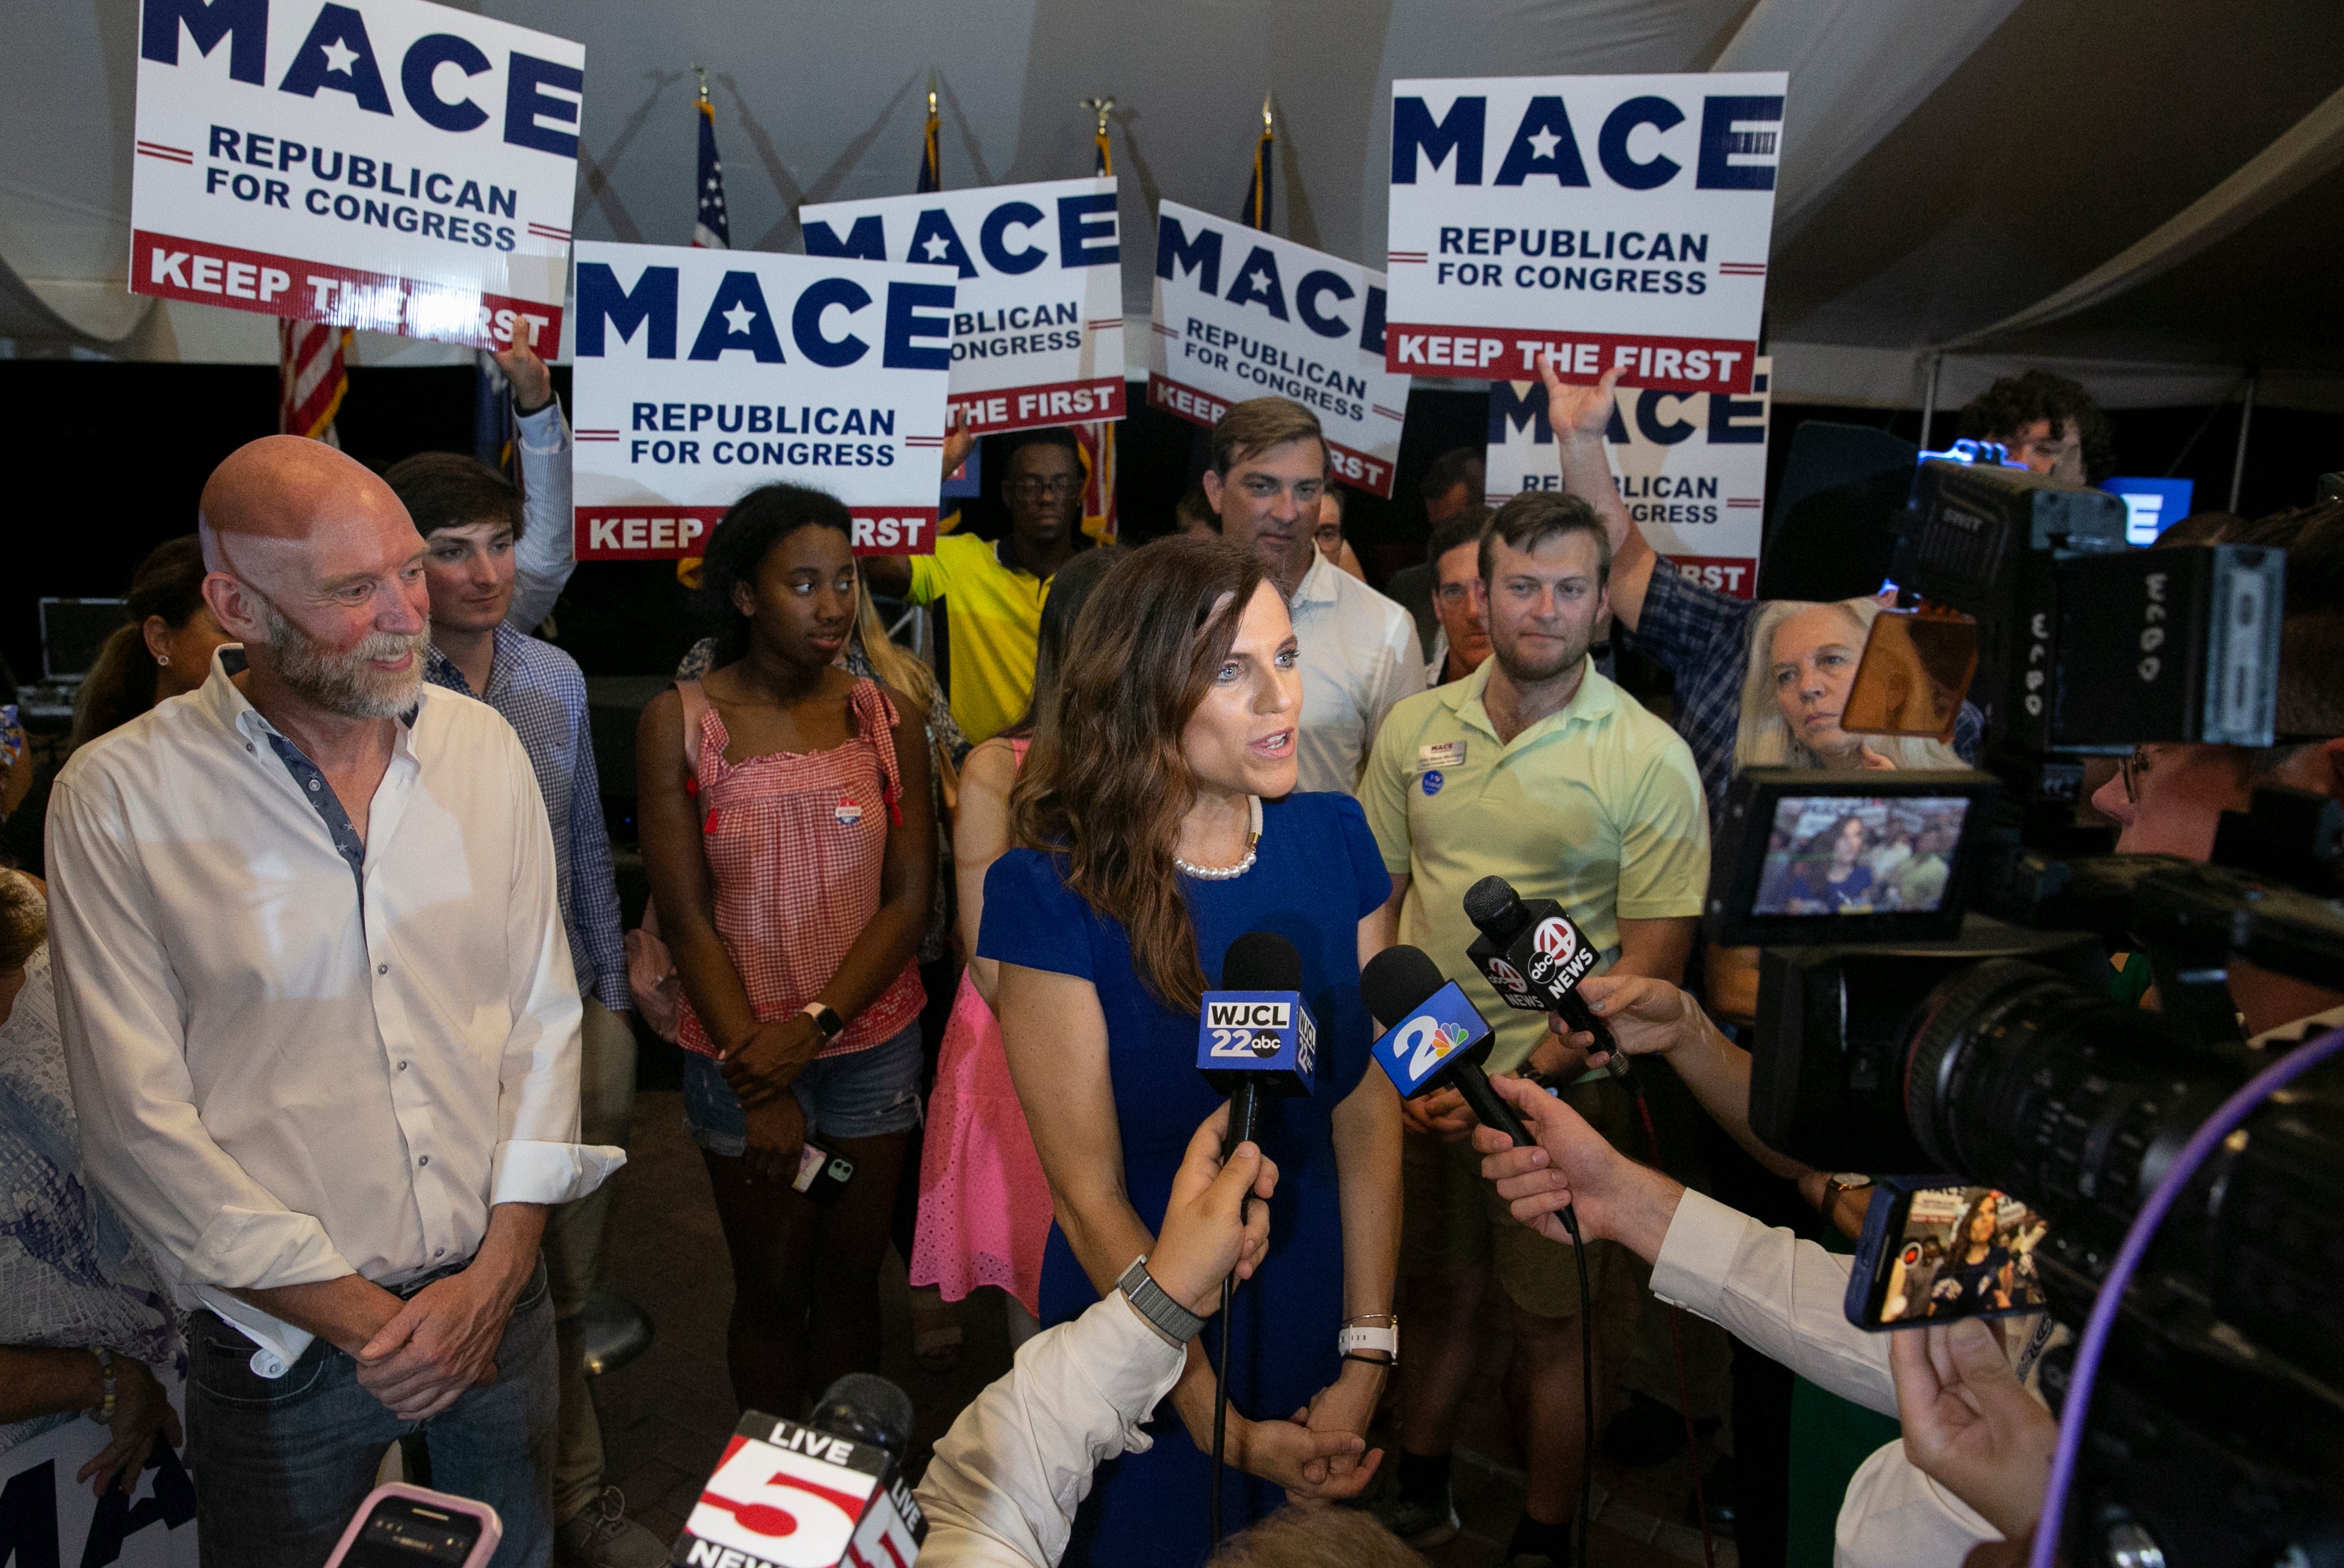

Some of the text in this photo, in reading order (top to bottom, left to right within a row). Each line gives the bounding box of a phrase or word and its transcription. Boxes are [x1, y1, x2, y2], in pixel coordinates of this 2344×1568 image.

[141, 0, 585, 160] MACE
[1391, 95, 1785, 191] MACE
[209, 124, 517, 218] REPUBLICAN
[206, 167, 516, 252] FOR CONGRESS
[1439, 227, 1708, 262] REPUBLICAN
[151, 248, 290, 302] KEEP
[440, 297, 549, 347] RST
[1437, 262, 1707, 295] FOR CONGRESS
[575, 262, 956, 371] MACE
[954, 302, 1078, 336] BLICAN
[950, 331, 1081, 361] ONGRESS
[1187, 318, 1366, 399] REPUBLICAN
[1397, 334, 1741, 382] KEEP THE FIRST
[1185, 342, 1364, 421] FOR CONGRESS
[632, 403, 895, 436] REPUBLICAN
[947, 385, 1115, 428] THE FIRST
[1156, 382, 1227, 423] KEEP
[631, 440, 894, 467] FOR CONGRESS
[1331, 447, 1385, 486] RST
[590, 518, 703, 549] KEEP
[852, 518, 926, 546] RST
[1631, 504, 1718, 524] GRESS
[1680, 565, 1747, 591] RST
[1488, 974, 1508, 985] abc
[1531, 955, 1553, 980] abc
[1548, 948, 1593, 999] NEWS
[1211, 1005, 1288, 1026] WJCL
[1505, 994, 1545, 1008] NEWS
[1210, 1029, 1281, 1057] 22 abc
[1300, 1010, 1315, 1052] WJCL
[1393, 1015, 1445, 1082] 2
[1298, 1036, 1308, 1075] 22
[768, 1422, 854, 1466] LIVE
[890, 1476, 922, 1534] LIVE
